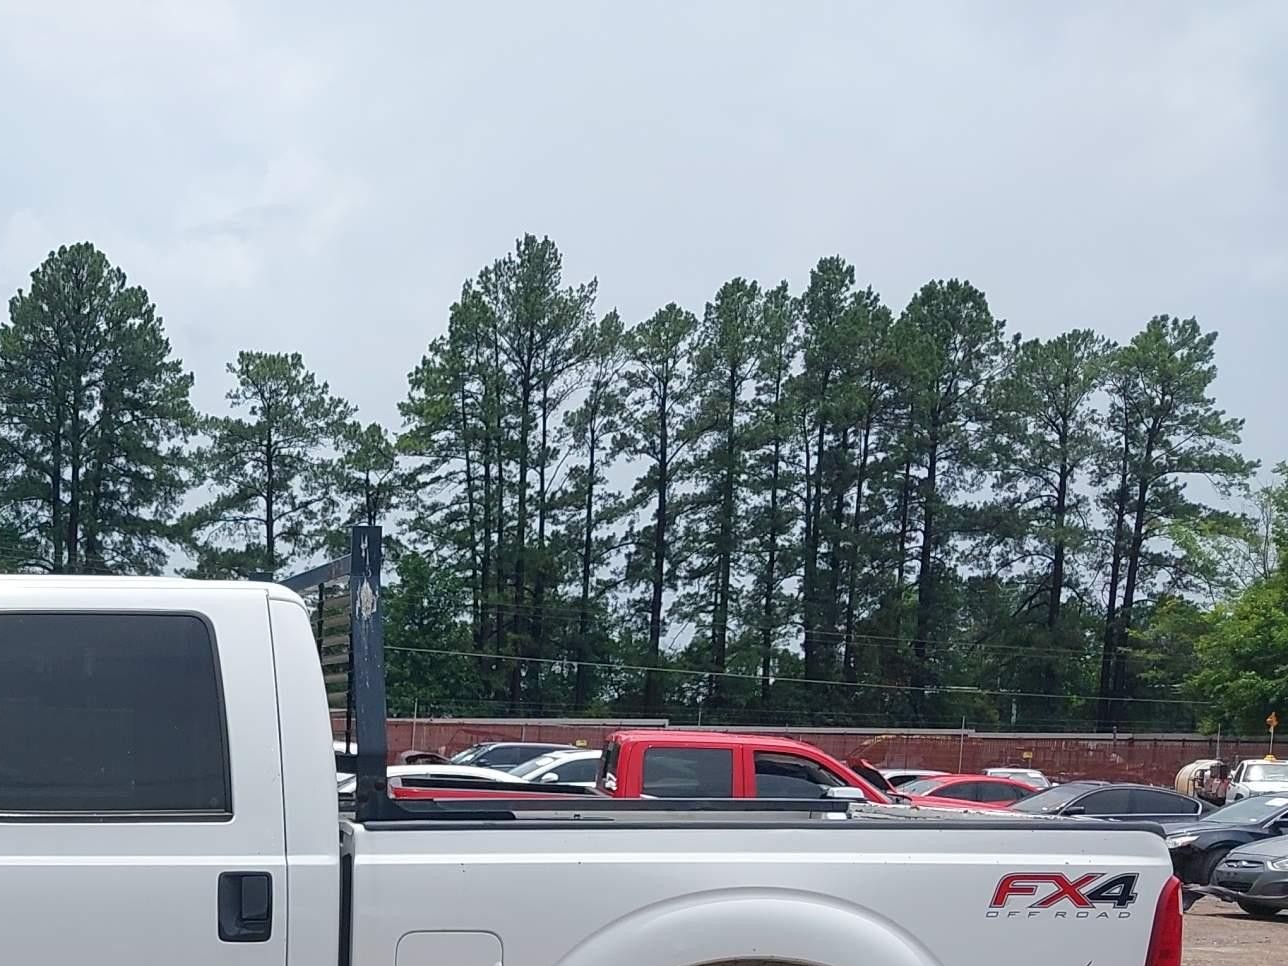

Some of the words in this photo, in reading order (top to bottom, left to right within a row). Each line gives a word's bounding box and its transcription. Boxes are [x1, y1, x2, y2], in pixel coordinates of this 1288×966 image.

[989, 872, 1140, 909] FX4
[985, 911, 1041, 919] OFF
[1054, 911, 1132, 919] ROAD
